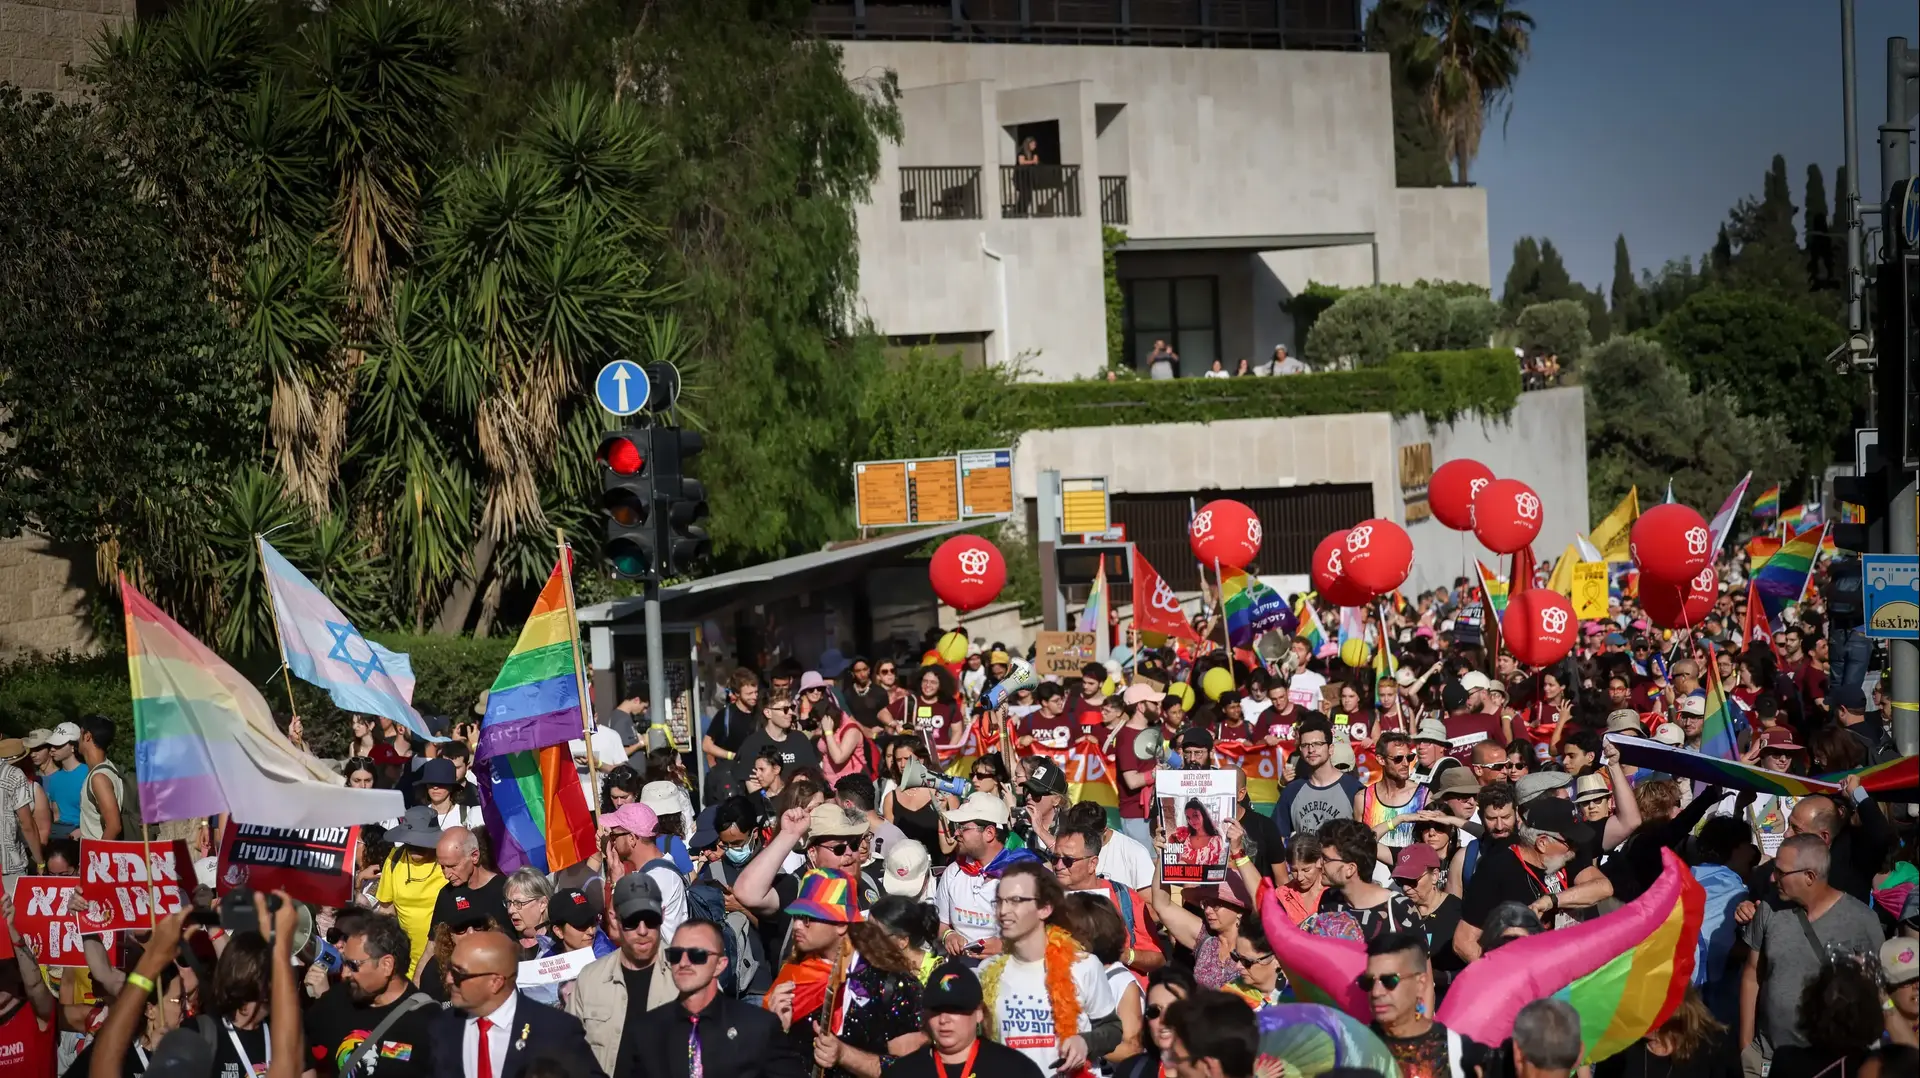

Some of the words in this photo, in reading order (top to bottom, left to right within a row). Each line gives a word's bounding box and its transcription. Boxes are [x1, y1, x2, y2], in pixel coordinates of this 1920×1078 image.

[1874, 615, 1902, 629] taxi
[1903, 618, 1919, 629] נית
[1299, 800, 1340, 819] AMERICAN
[238, 842, 288, 863] עכשיו!
[290, 849, 335, 870] שוויון
[1164, 854, 1178, 865] HER
[87, 851, 181, 883] אמא
[1164, 865, 1183, 877] HOME
[1185, 865, 1203, 877] NOW!
[115, 885, 189, 922] כאן
[955, 907, 990, 926] עתיד
[1002, 1019, 1055, 1034] חופשית
